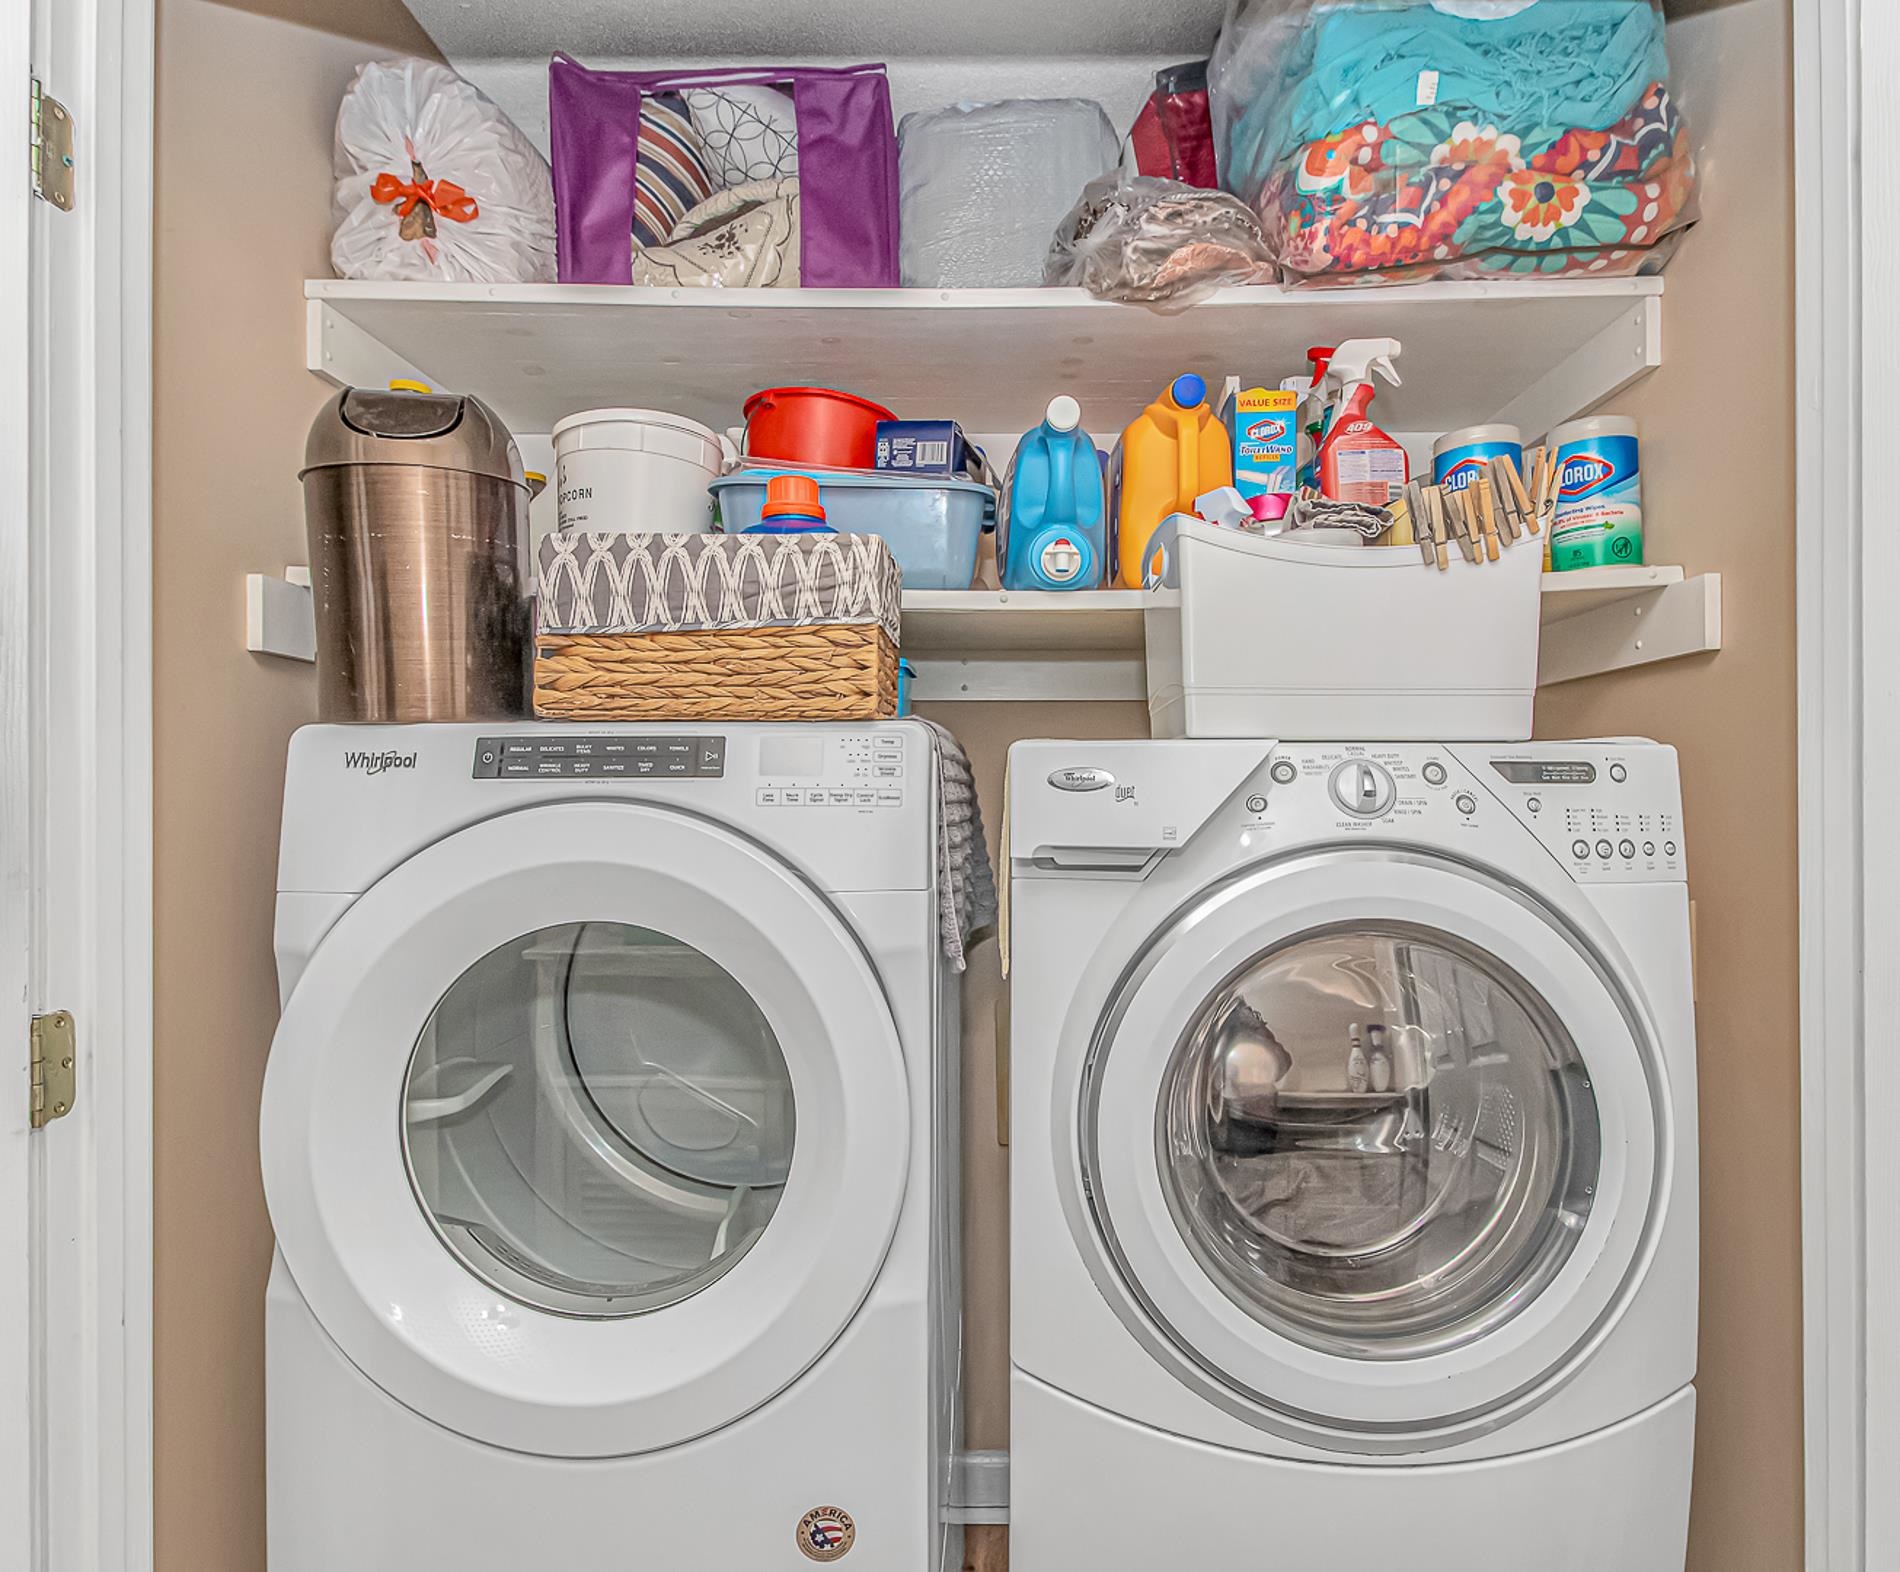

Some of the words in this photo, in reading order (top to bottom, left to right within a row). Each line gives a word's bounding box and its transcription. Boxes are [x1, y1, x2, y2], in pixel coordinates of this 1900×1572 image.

[1239, 398, 1271, 407] VALUE
[1273, 397, 1292, 406] SIZE
[1250, 424, 1282, 438] CLOROX
[1346, 421, 1373, 432] 409
[1445, 469, 1478, 491] CLOR
[1561, 463, 1604, 487] LOROX
[345, 750, 417, 775] Whirlpool
[1065, 772, 1096, 788] Whirlpool
[803, 1508, 852, 1531] AMERICA
